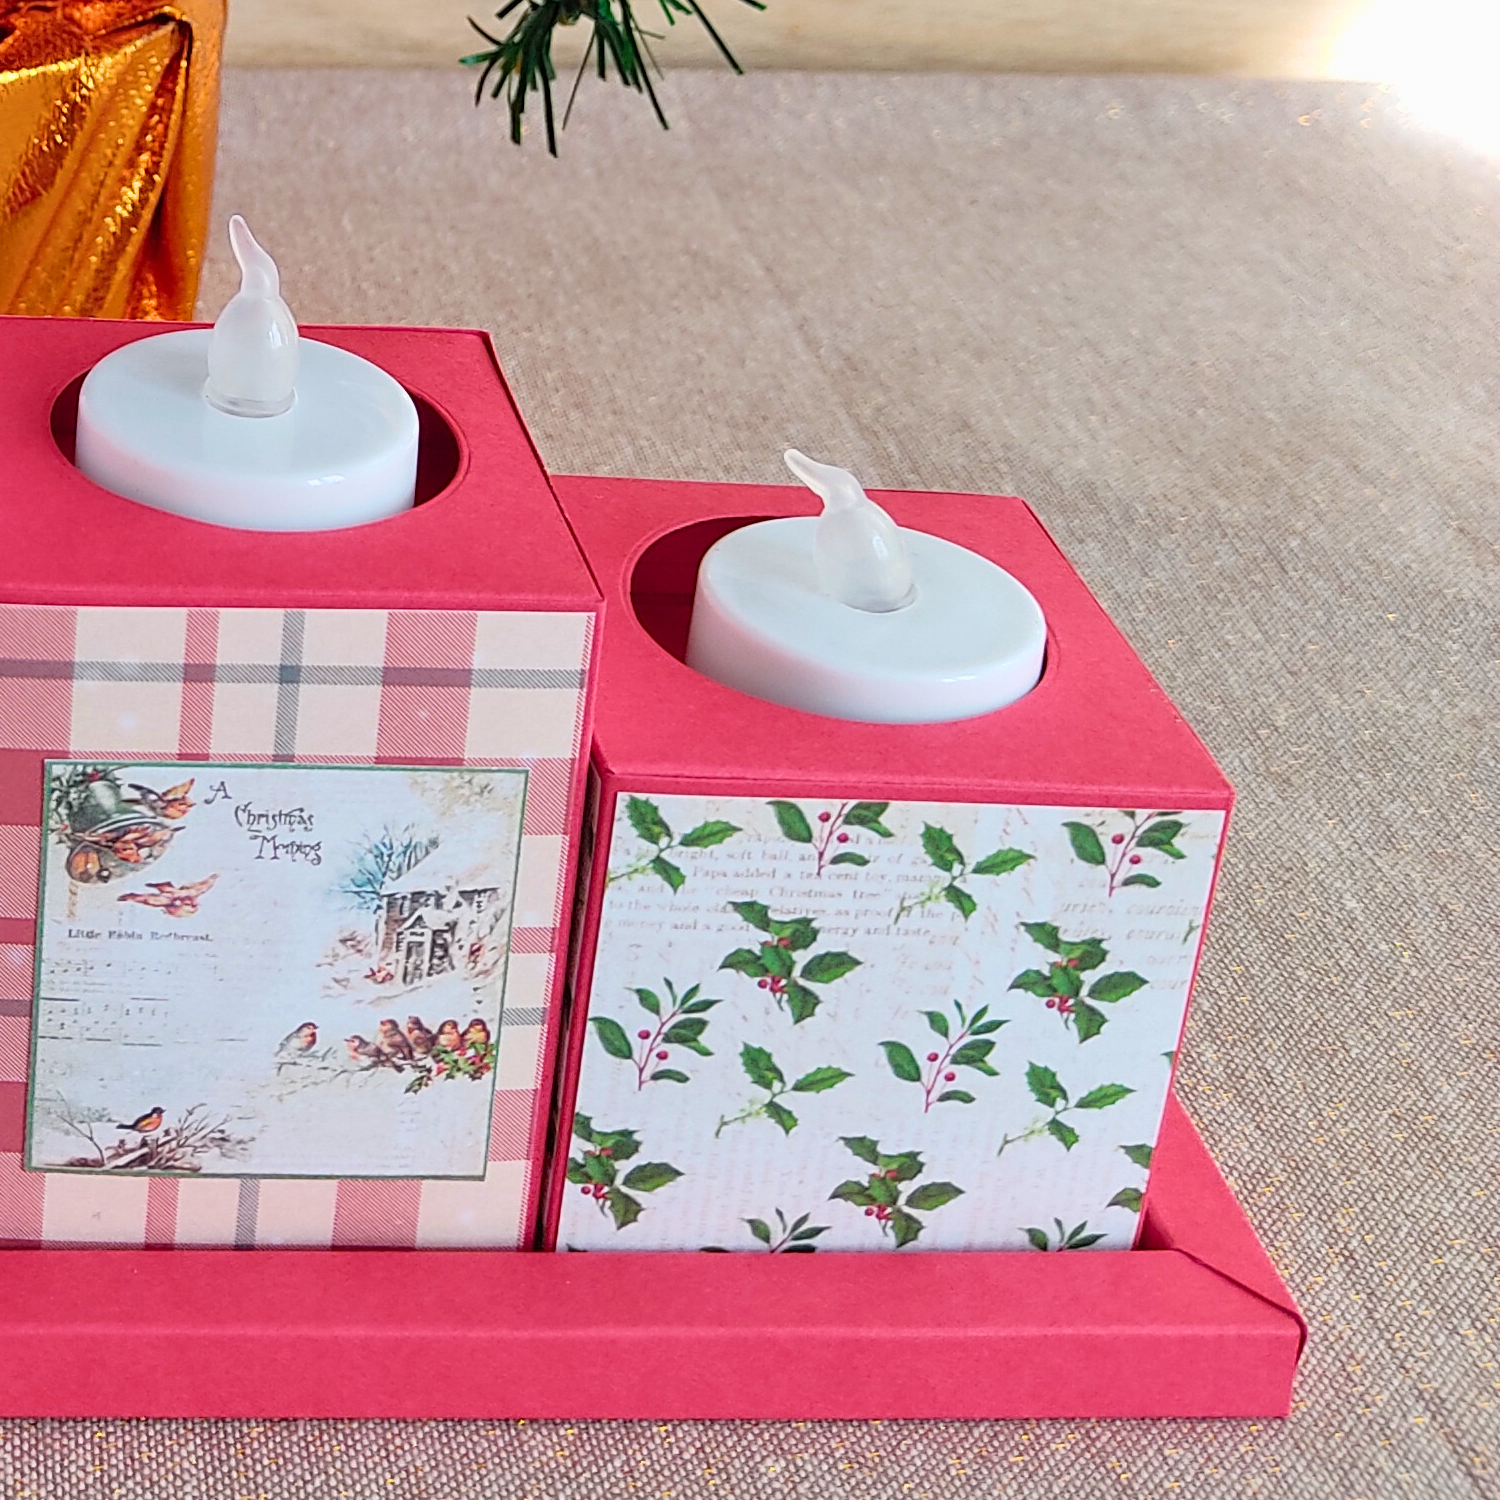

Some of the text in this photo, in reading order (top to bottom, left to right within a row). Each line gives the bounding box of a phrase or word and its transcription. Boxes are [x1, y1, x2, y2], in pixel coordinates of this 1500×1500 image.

[202, 780, 233, 805] A
[234, 801, 315, 833] Christmas
[249, 834, 323, 866] Morning
